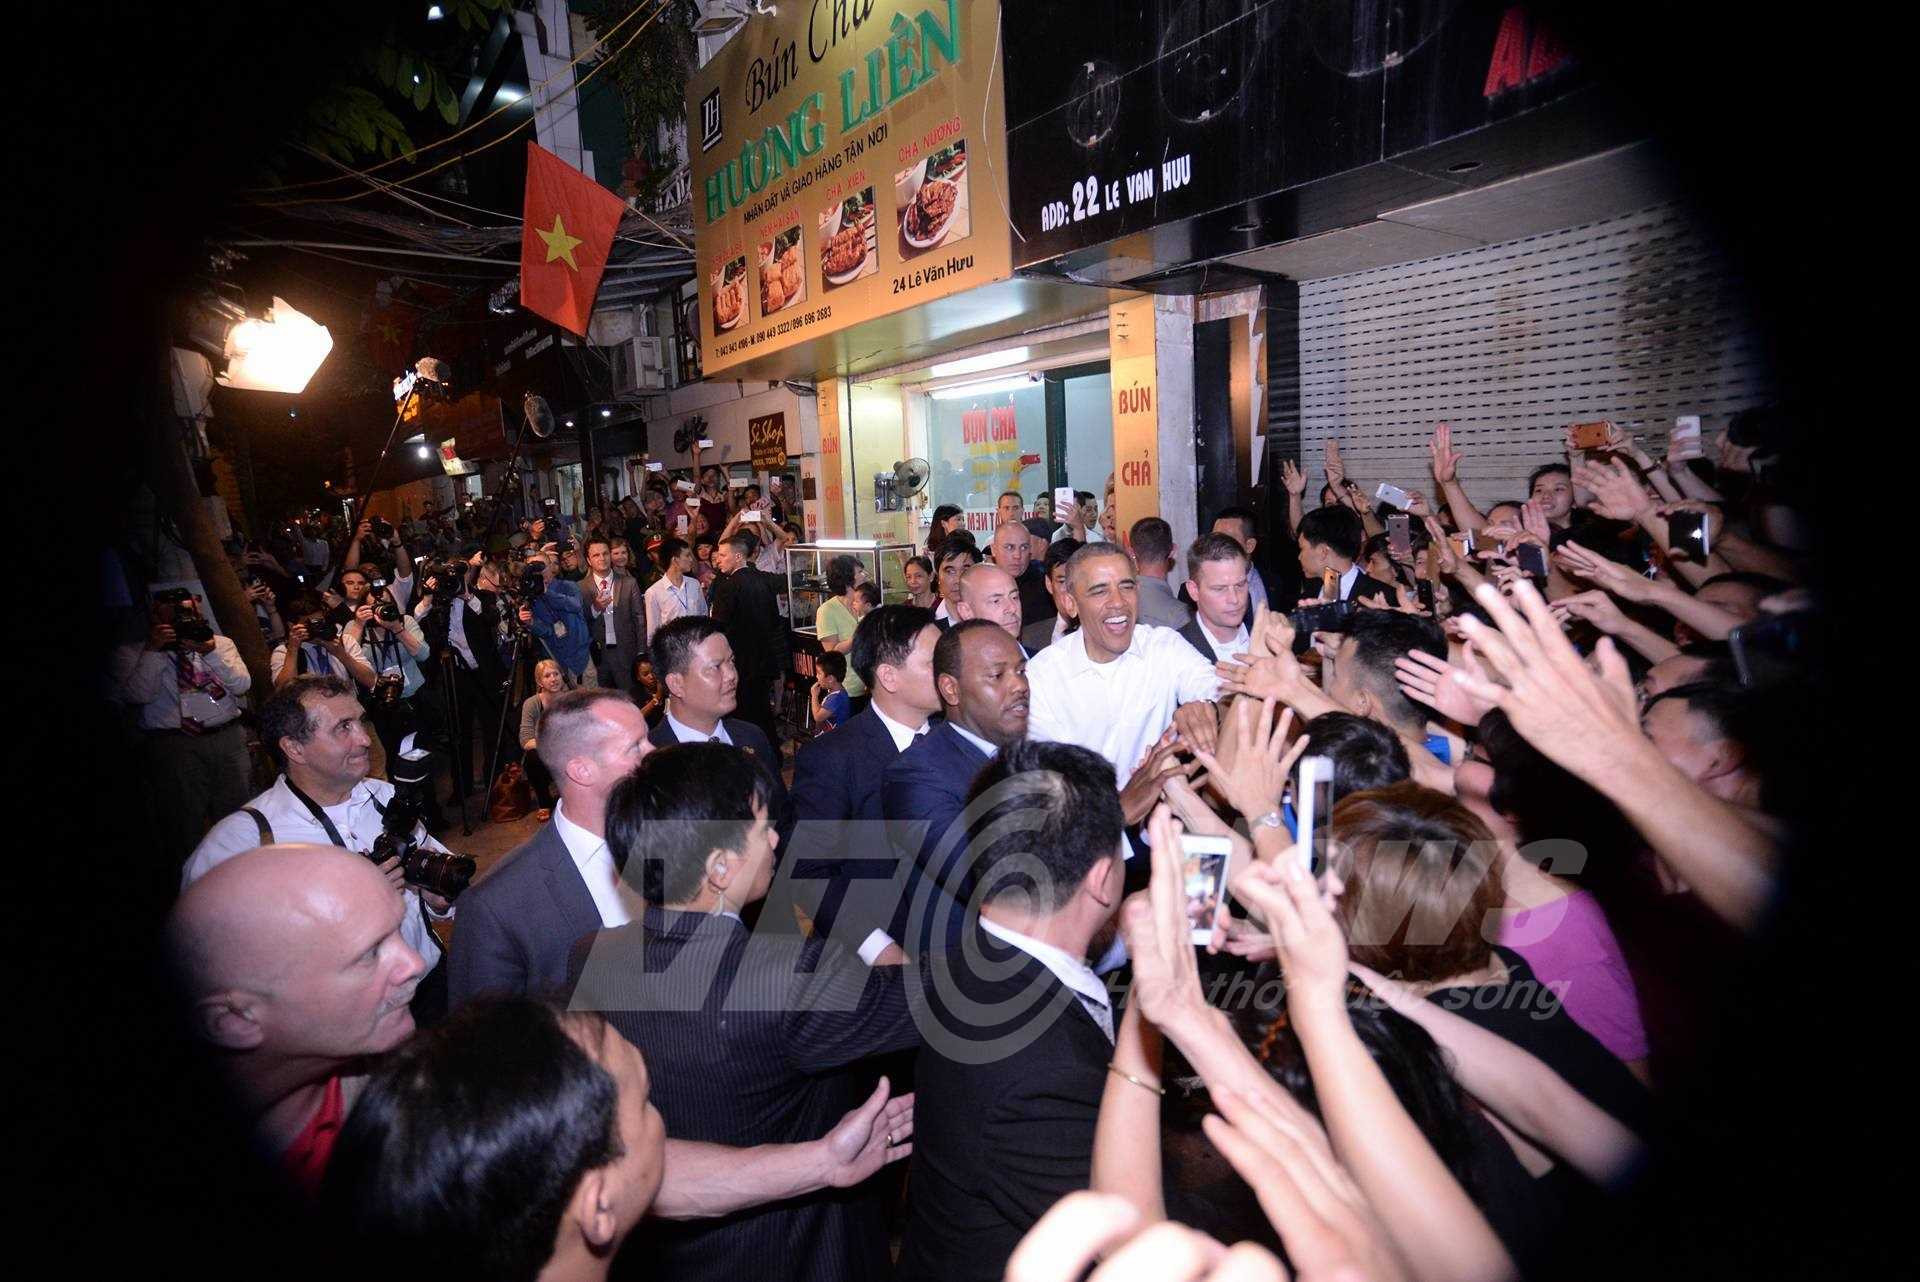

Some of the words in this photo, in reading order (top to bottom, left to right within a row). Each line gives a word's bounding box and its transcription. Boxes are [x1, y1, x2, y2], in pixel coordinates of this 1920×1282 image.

[745, 37, 798, 115] Bún
[839, 0, 962, 134] LIÊN
[792, 171, 813, 195] GIAO
[815, 153, 842, 181] HÀNG
[1041, 201, 1069, 232] ADD:
[1072, 175, 1100, 222] 22
[1105, 180, 1120, 211] LE
[1126, 168, 1154, 204] VAN
[1162, 154, 1191, 192] HUU
[893, 276, 906, 294] 24
[908, 271, 921, 289] Lê
[923, 266, 945, 283] Văn
[1119, 380, 1151, 414] BÚN
[822, 433, 839, 454] BÚN
[962, 402, 988, 445] BÚN
[1121, 449, 1152, 488] CHẢ
